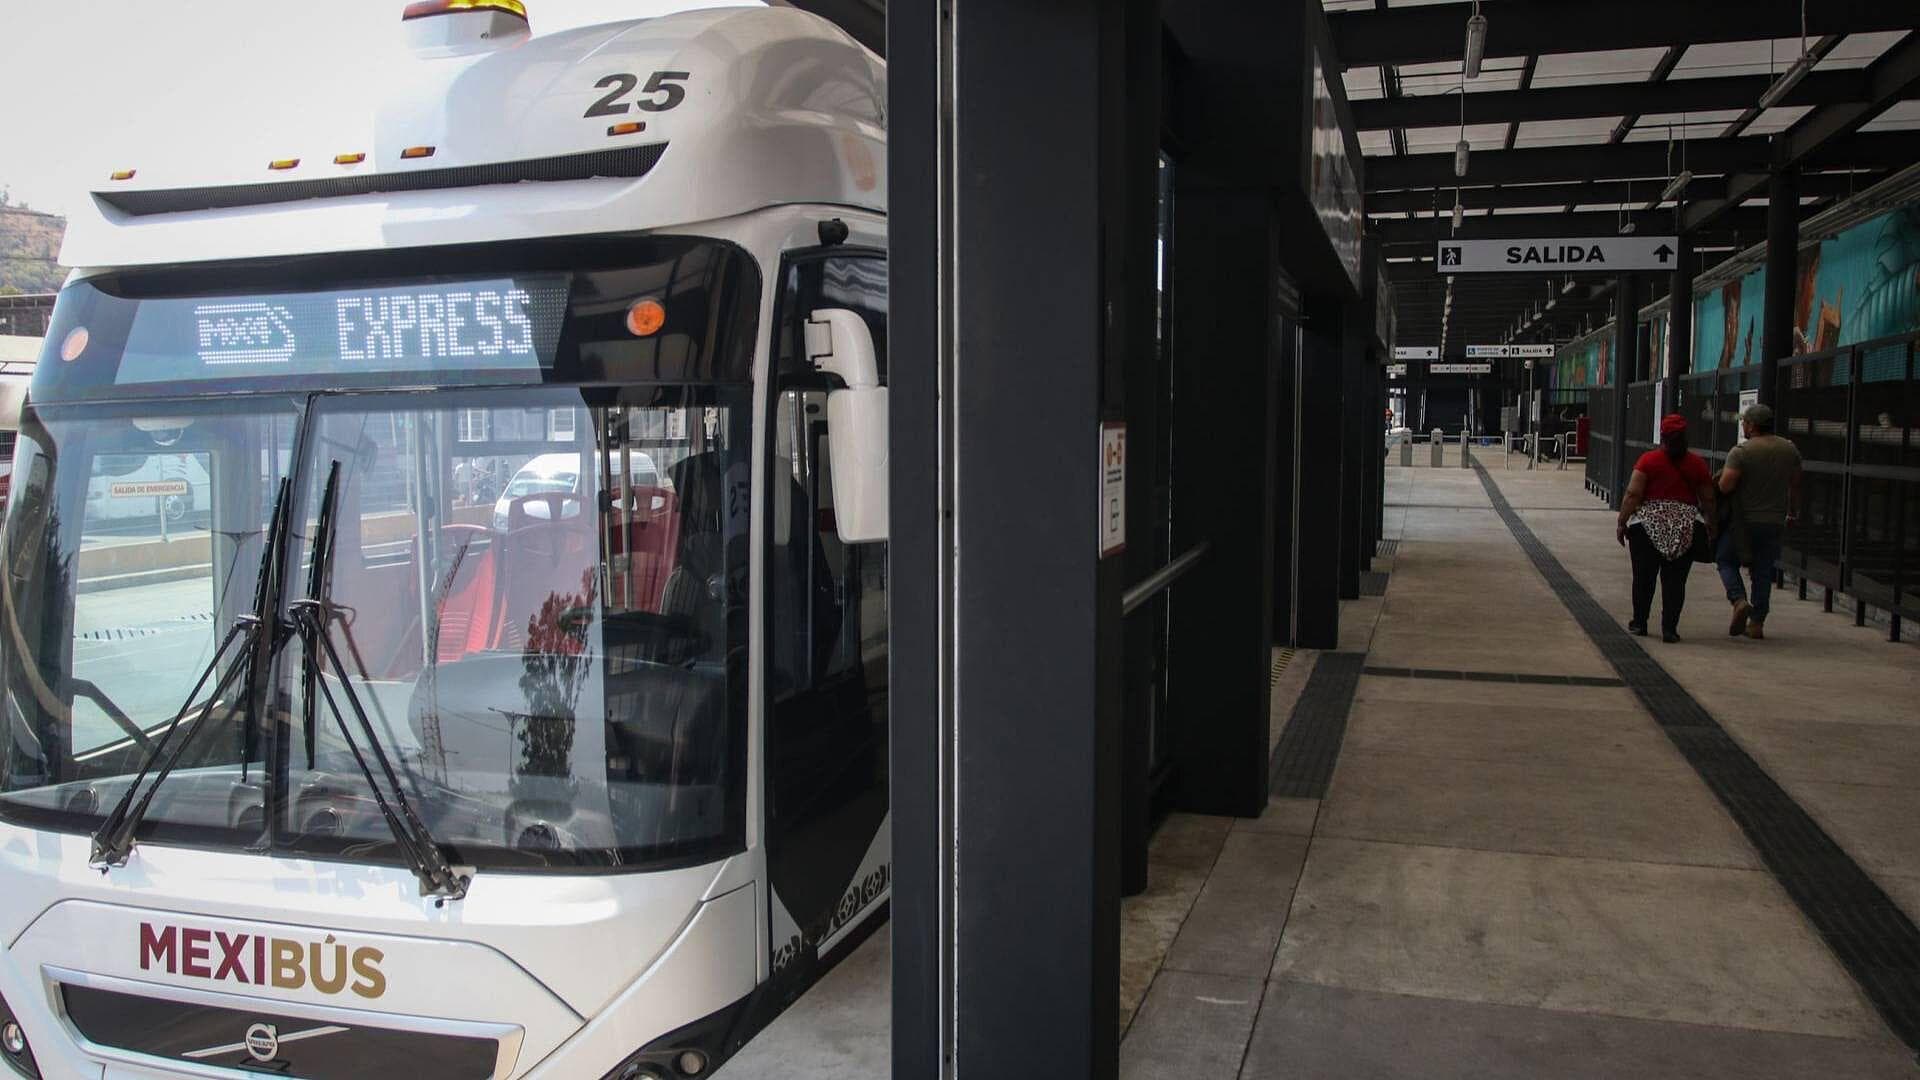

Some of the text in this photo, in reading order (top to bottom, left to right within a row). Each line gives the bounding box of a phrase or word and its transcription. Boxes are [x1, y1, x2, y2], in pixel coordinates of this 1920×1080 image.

[583, 71, 690, 118] 25
[1506, 245, 1606, 264] SALIDA
[337, 290, 532, 359] EXPRESS
[114, 486, 136, 494] SALIDA
[146, 484, 185, 492] EMERGENCIA
[139, 922, 387, 999] MEXIBÚS
[248, 1038, 275, 1048] VOLVO
